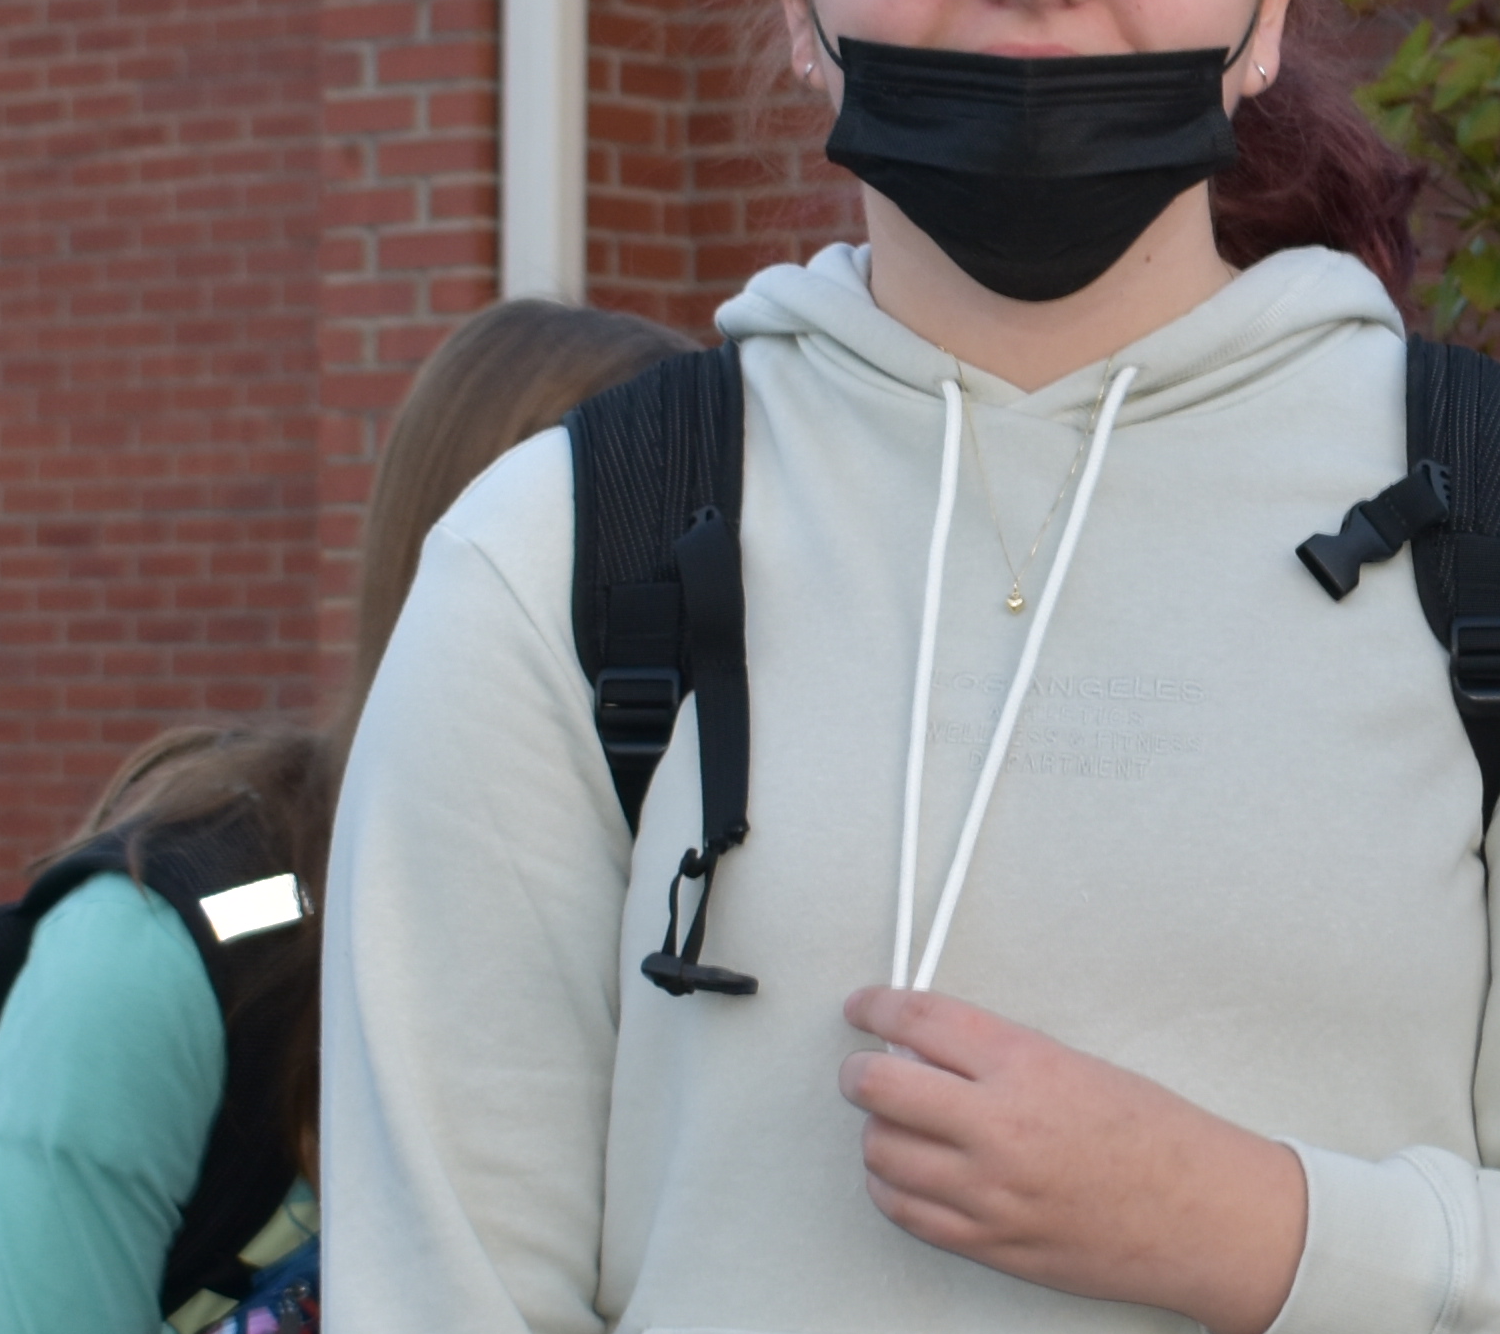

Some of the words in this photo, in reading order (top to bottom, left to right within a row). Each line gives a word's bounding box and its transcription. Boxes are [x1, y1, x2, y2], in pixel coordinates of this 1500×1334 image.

[932, 671, 1005, 695] LOS
[1024, 674, 1205, 704] ANGELES
[990, 703, 1143, 726] AHLETICS
[926, 721, 1059, 748] WELLESS
[1096, 730, 1202, 754] FITNESS
[969, 749, 1150, 780] DPARTMENT
